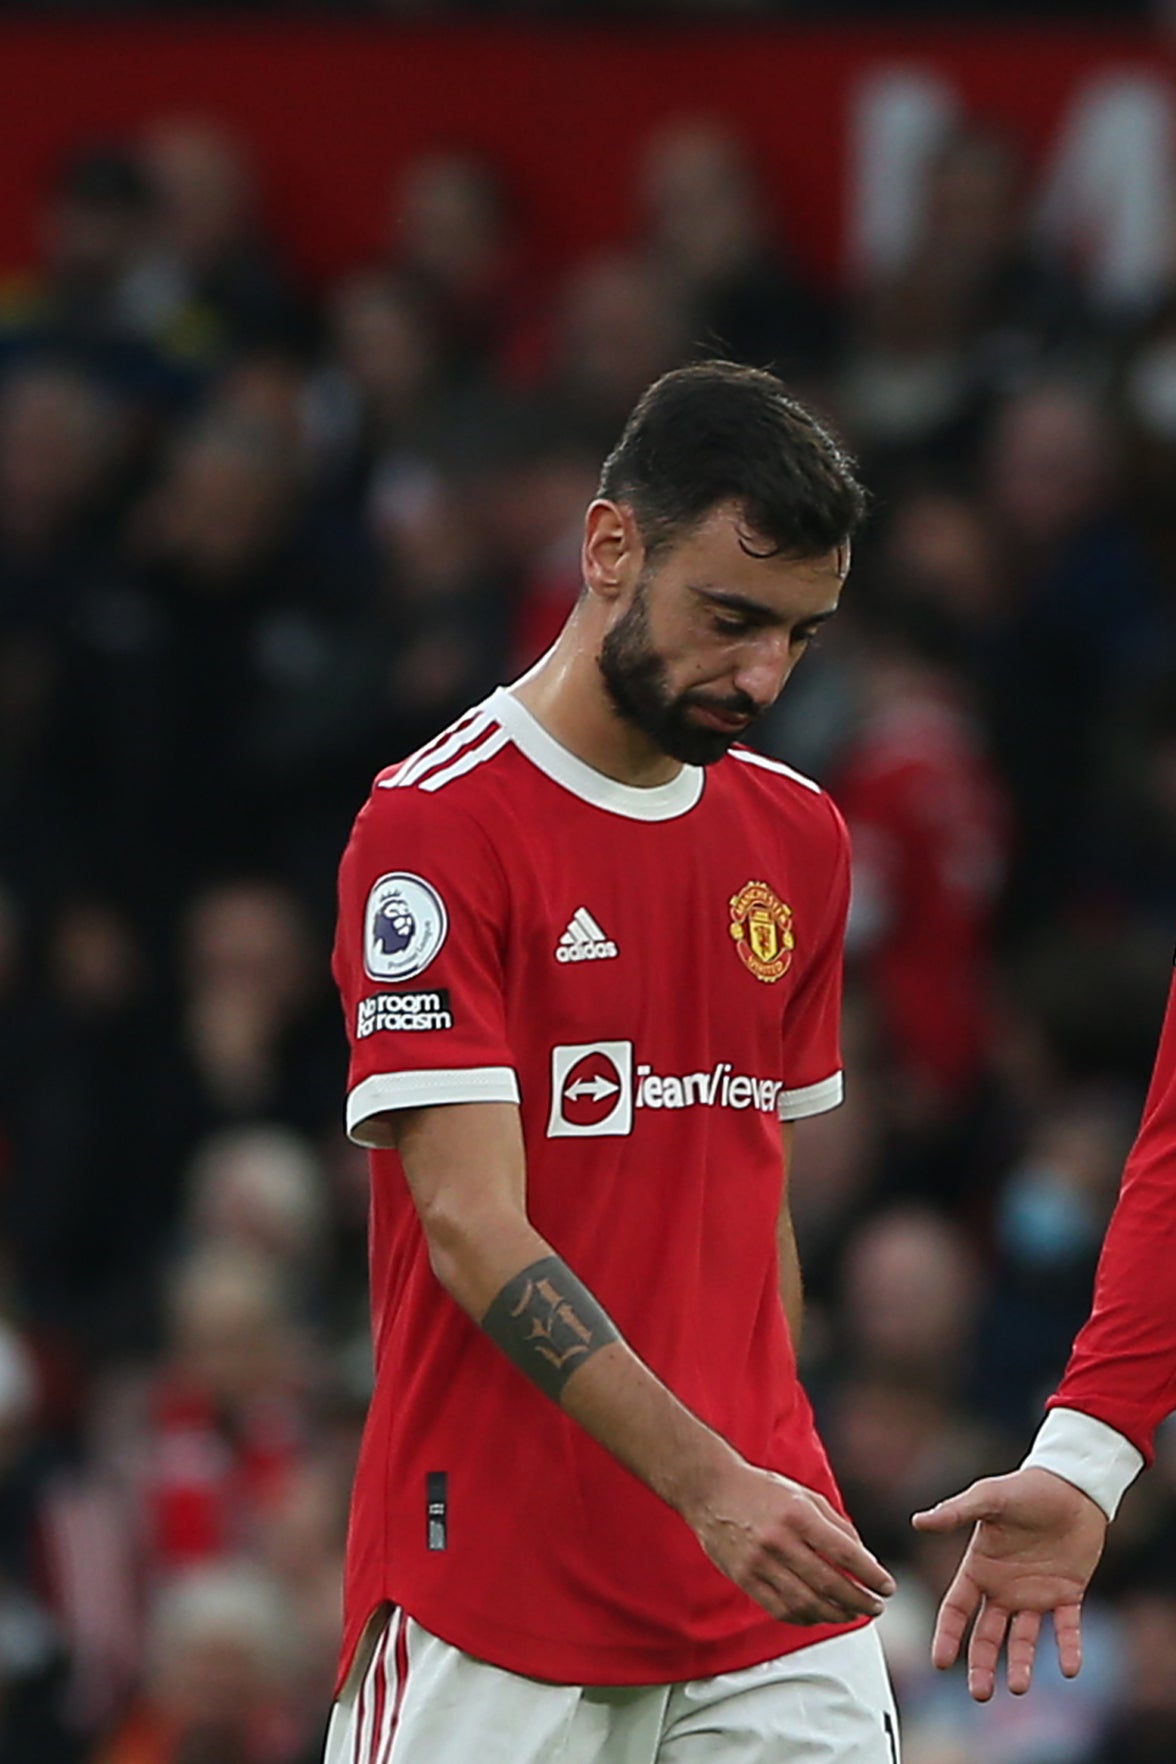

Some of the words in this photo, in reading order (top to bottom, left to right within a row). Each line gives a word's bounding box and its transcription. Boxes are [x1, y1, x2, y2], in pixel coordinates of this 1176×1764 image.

[556, 940, 618, 963] adidas
[378, 993, 440, 1014] room
[376, 1011, 452, 1032] racism
